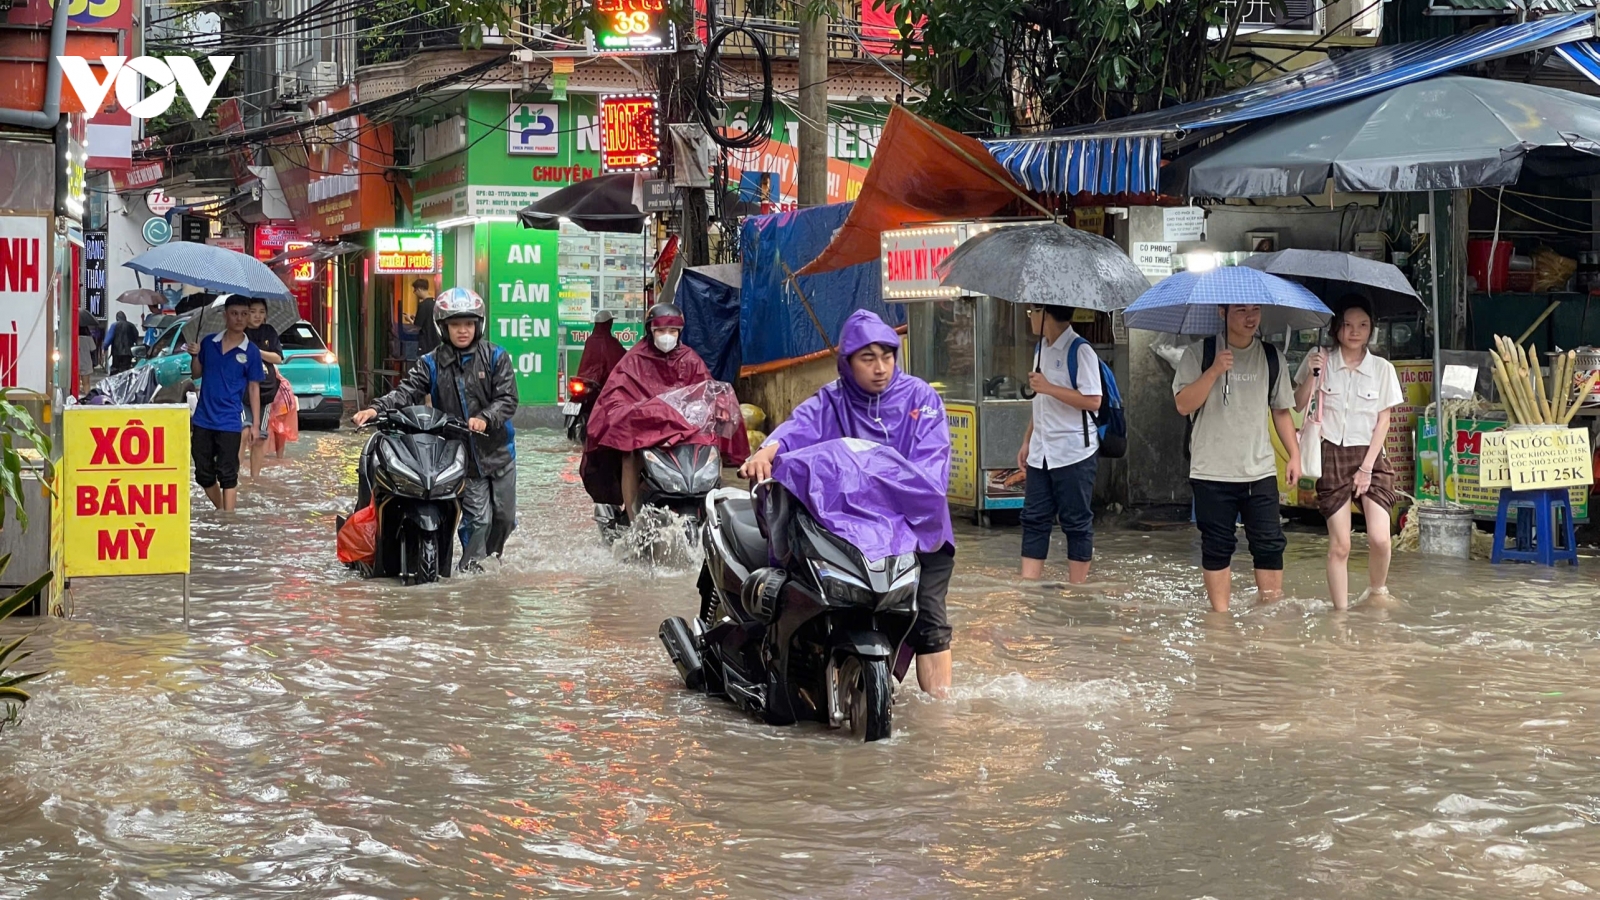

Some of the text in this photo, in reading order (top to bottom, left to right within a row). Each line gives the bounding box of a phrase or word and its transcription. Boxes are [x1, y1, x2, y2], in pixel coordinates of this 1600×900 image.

[614, 11, 650, 34] 38
[532, 163, 593, 183] CHUYÊN
[86, 235, 105, 260] RĂNG
[507, 245, 541, 264] AN
[407, 252, 432, 268] PHÚC
[888, 242, 912, 281] BÁNH
[1140, 255, 1153, 264] CHO
[86, 261, 105, 289] THẨM
[498, 279, 550, 302] TÂM
[90, 292, 101, 315] MỸ
[497, 314, 550, 341] TIỆN
[614, 327, 638, 342] TỐT
[89, 419, 165, 465] XÔI
[1510, 431, 1586, 451] NƯỚC MÍA
[1511, 452, 1527, 460] CỐC
[1511, 459, 1527, 468] CỐC
[1553, 456, 1569, 465] CỐC
[1571, 455, 1585, 463] 15K
[1519, 466, 1585, 484] LÍT 25K
[76, 479, 178, 517] BÁNH
[98, 522, 156, 561] MỲ
